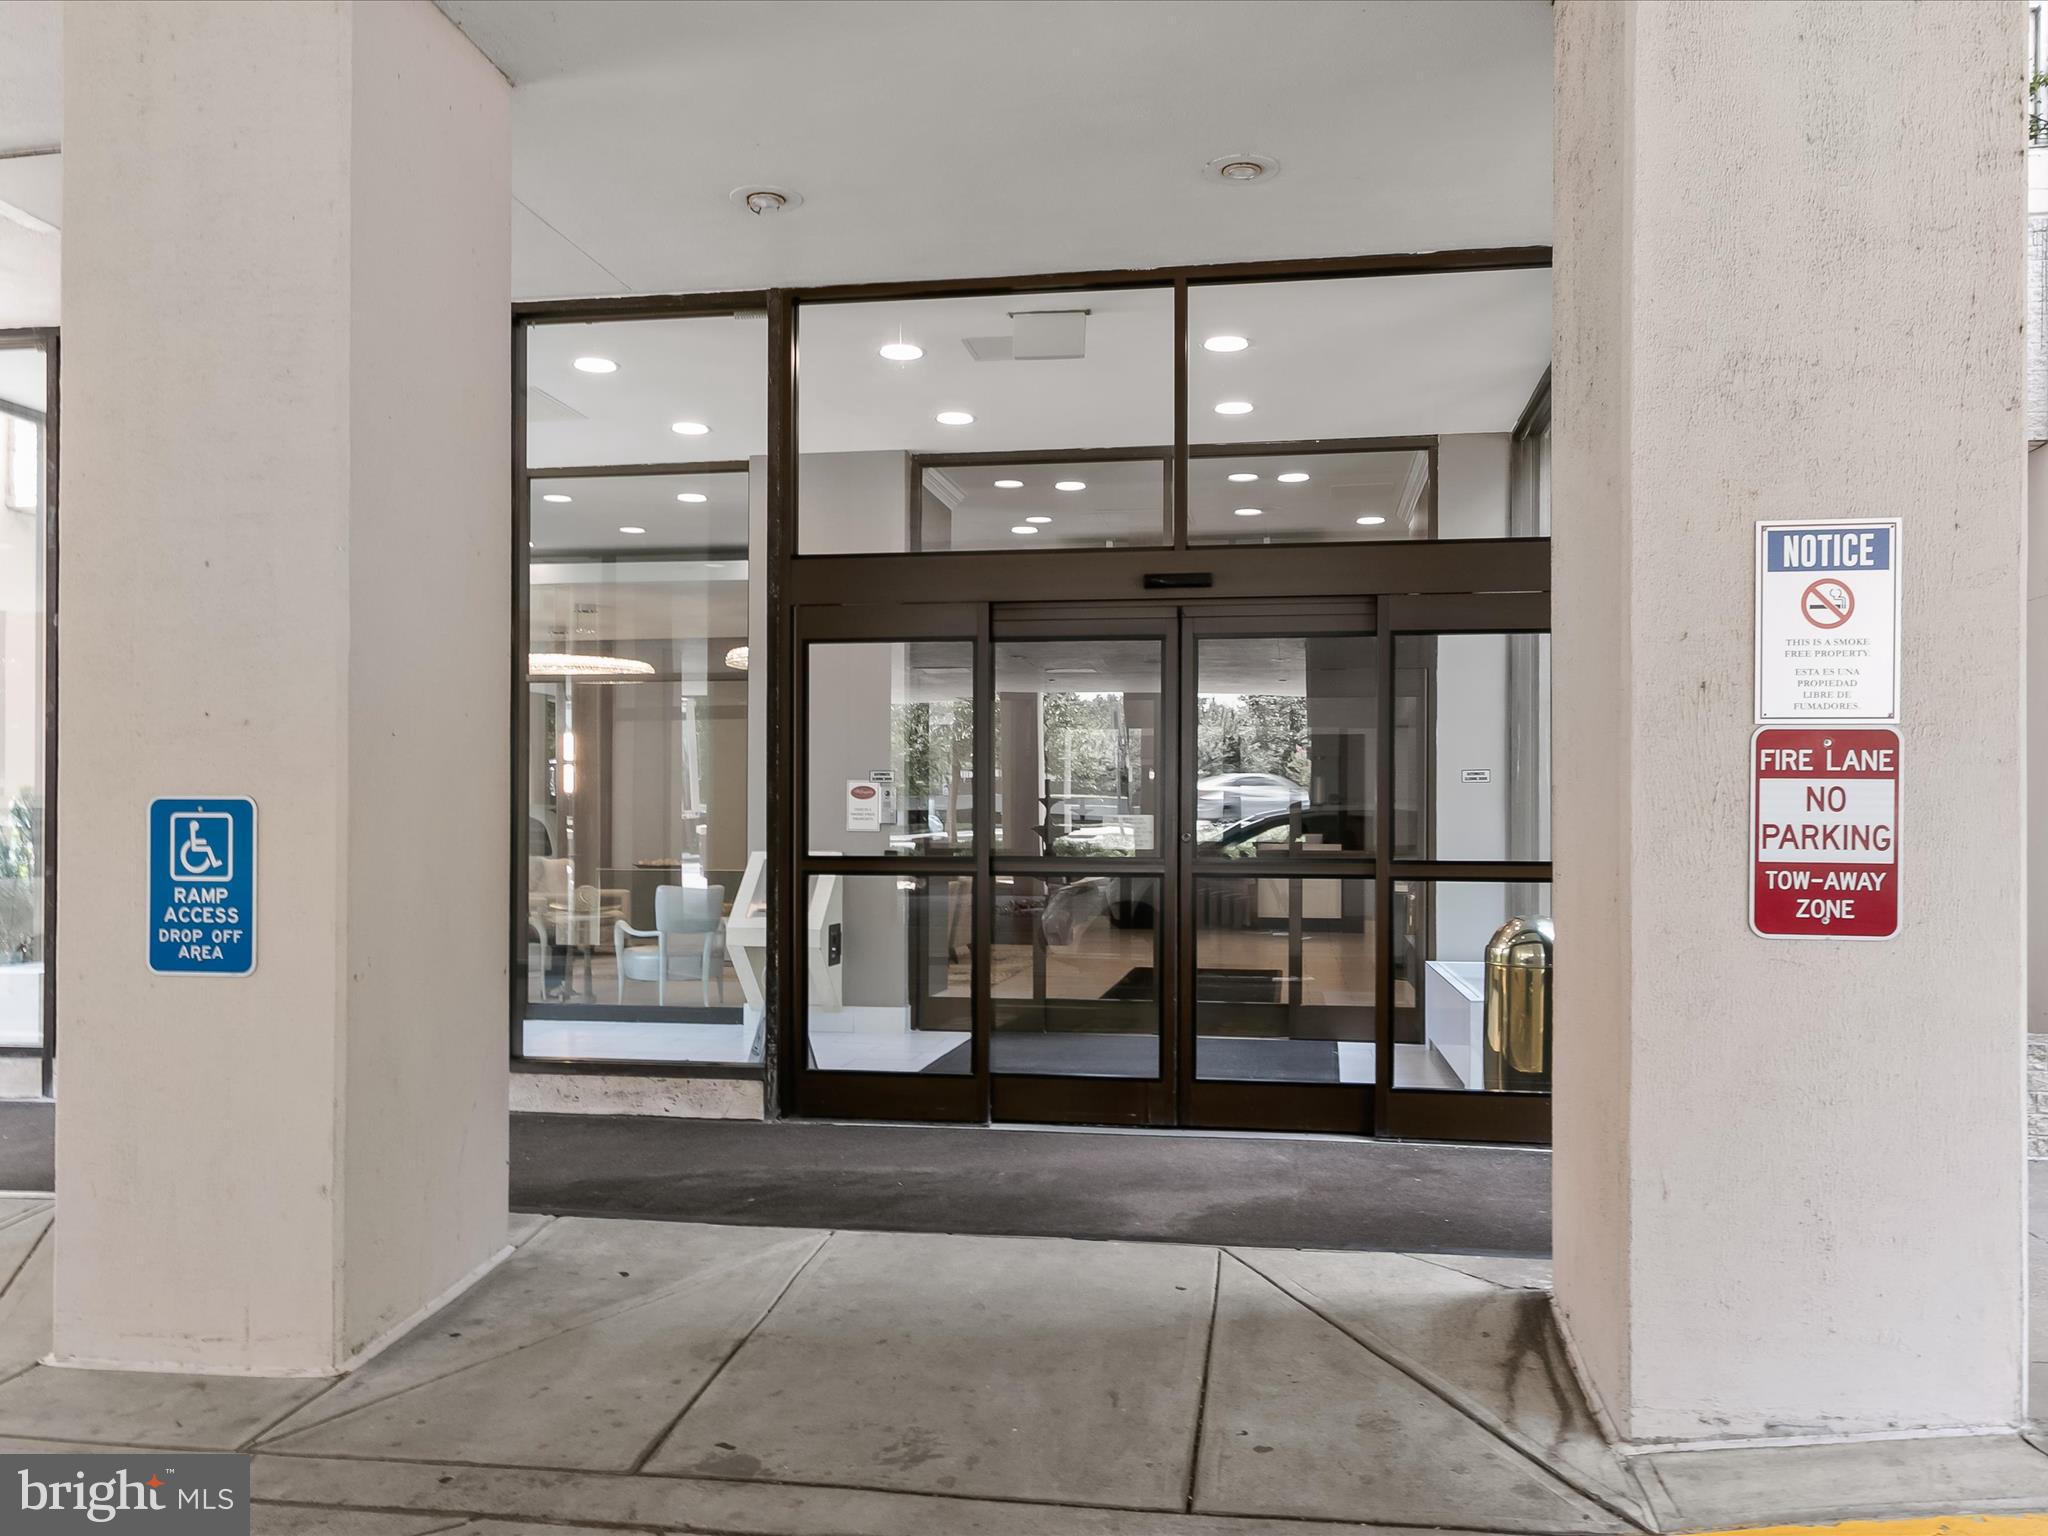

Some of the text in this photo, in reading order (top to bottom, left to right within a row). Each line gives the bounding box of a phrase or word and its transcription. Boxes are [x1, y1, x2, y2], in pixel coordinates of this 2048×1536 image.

[1783, 533, 1875, 568] NOTICE
[1785, 637, 1871, 646] THIS IS A SMOKE
[1784, 649, 1812, 658] FREE
[1795, 668, 1860, 676] ESTA ES UNA
[1797, 679, 1858, 688] PROPIEDAD
[1803, 691, 1852, 699] LIBRE DE
[1760, 749, 1895, 772] FIRE LANE
[1806, 785, 1847, 813] NO
[1761, 823, 1892, 851] PARKING
[1764, 870, 1887, 892] TOW-AWAY
[174, 886, 229, 904] RAMP
[163, 906, 240, 924] ACCESS
[1795, 898, 1856, 919] ZONE
[158, 928, 244, 944] DROP OFF
[178, 945, 224, 961] AREA
